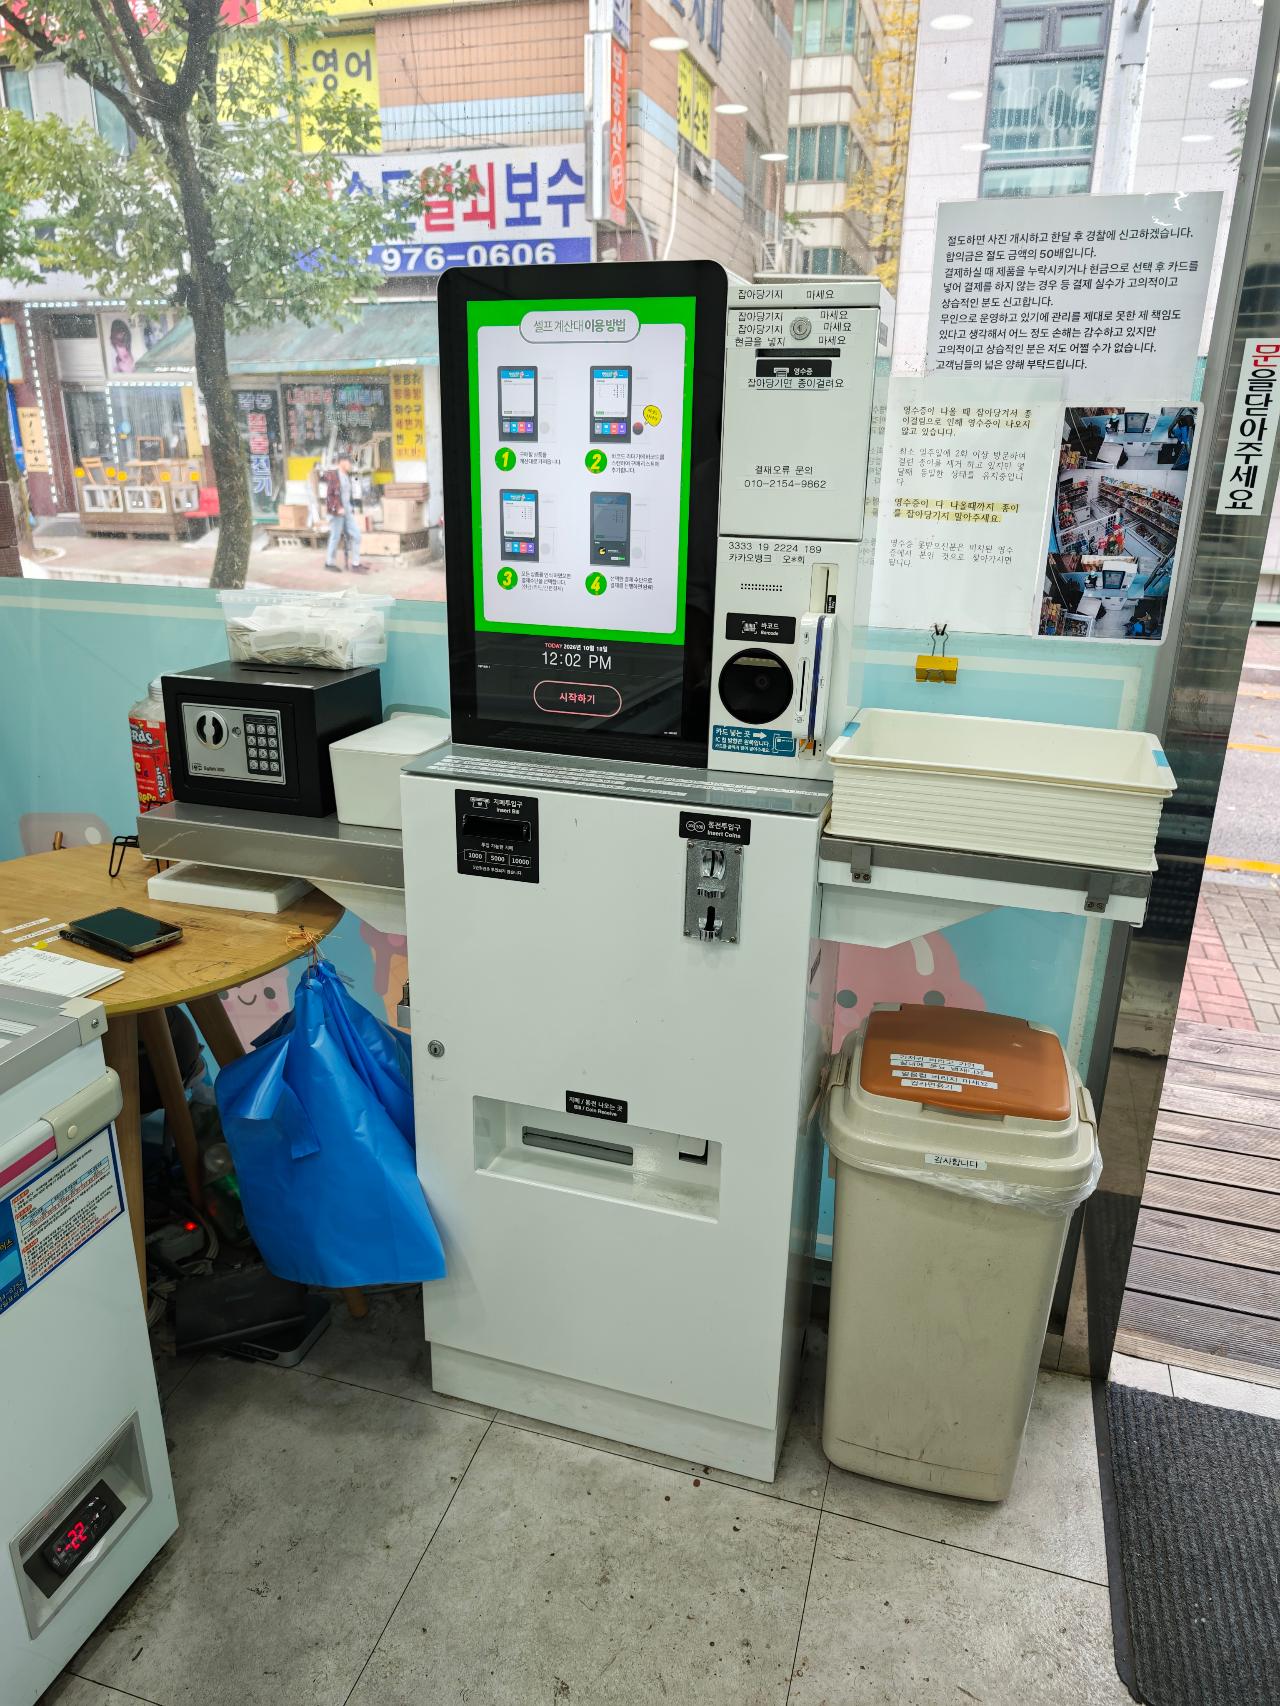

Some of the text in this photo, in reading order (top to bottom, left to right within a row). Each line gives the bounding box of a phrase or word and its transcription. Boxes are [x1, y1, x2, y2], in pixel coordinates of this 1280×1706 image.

[312, 48, 372, 92] 영어
[948, 235, 985, 247] 절도하면
[987, 234, 1007, 245] 사진
[1051, 232, 1071, 243] 한달
[1073, 231, 1083, 242] 후
[1086, 230, 1116, 242] 경찰에
[1119, 227, 1194, 240] 신고하겠습니다.
[380, 242, 557, 273] 976-0606
[946, 247, 1097, 263] 합의금은 절도 금액의 50배입니다.
[944, 266, 982, 279] 결제하실
[985, 266, 994, 277] 때
[996, 265, 1025, 277] 제품을
[1028, 263, 1087, 276] 누락시키거나
[1133, 262, 1153, 273] 선택
[1155, 261, 1165, 272] 후
[1167, 260, 1199, 272] 카드를
[944, 277, 1178, 293] 넣어 결제를 하지 않는 경우 등 결제 실수가 고의적이고
[738, 290, 834, 300] 잡아당기지 마세요
[941, 296, 1053, 309] 상습적인 분도 신고합니다.
[738, 310, 848, 322] 잡아당기지 마세요
[940, 309, 1182, 324] 무인으로 운영하고 있기에 관리를 제대로 못한 제 책임도
[534, 320, 553, 333] 셀프
[555, 320, 584, 333] 계산대
[738, 322, 852, 335] 잡아당기지 마세요
[939, 325, 1156, 340] 있다고 생각해서 어느 정도 손해는 감수하고 있지만
[736, 336, 846, 347] 현금을 넣지 마세요
[938, 342, 1157, 355] 고의적이고 상습적인 분은 저도 어쩔 수가 없습니다.
[936, 359, 982, 370] 고객님들의
[1005, 358, 1024, 370] 양해
[1027, 358, 1087, 370] 부탁드립니다.
[794, 368, 813, 376] 영수증
[748, 379, 844, 389] 잡아당기면 종이걸려요
[904, 406, 935, 416] 영수증이
[963, 408, 970, 416] 때
[968, 418, 1000, 429] 영수증이
[1225, 344, 1280, 510] 문을닫아주세요
[502, 452, 509, 467] 1
[592, 453, 601, 469] 2
[795, 466, 813, 476] 문의
[744, 480, 827, 489] 010-2154-9862
[935, 500, 943, 509] 다
[906, 509, 950, 521] 잡아당기지
[728, 542, 822, 554] 3333 19 2224 189
[728, 554, 772, 563] 카카오뱅크
[503, 572, 512, 586] 3
[591, 577, 601, 592] 4
[761, 622, 780, 630] 바코드
[542, 651, 612, 670] 12:02 PM
[560, 692, 596, 705] 시작하기
[934, 1156, 978, 1169] 감사합니다
